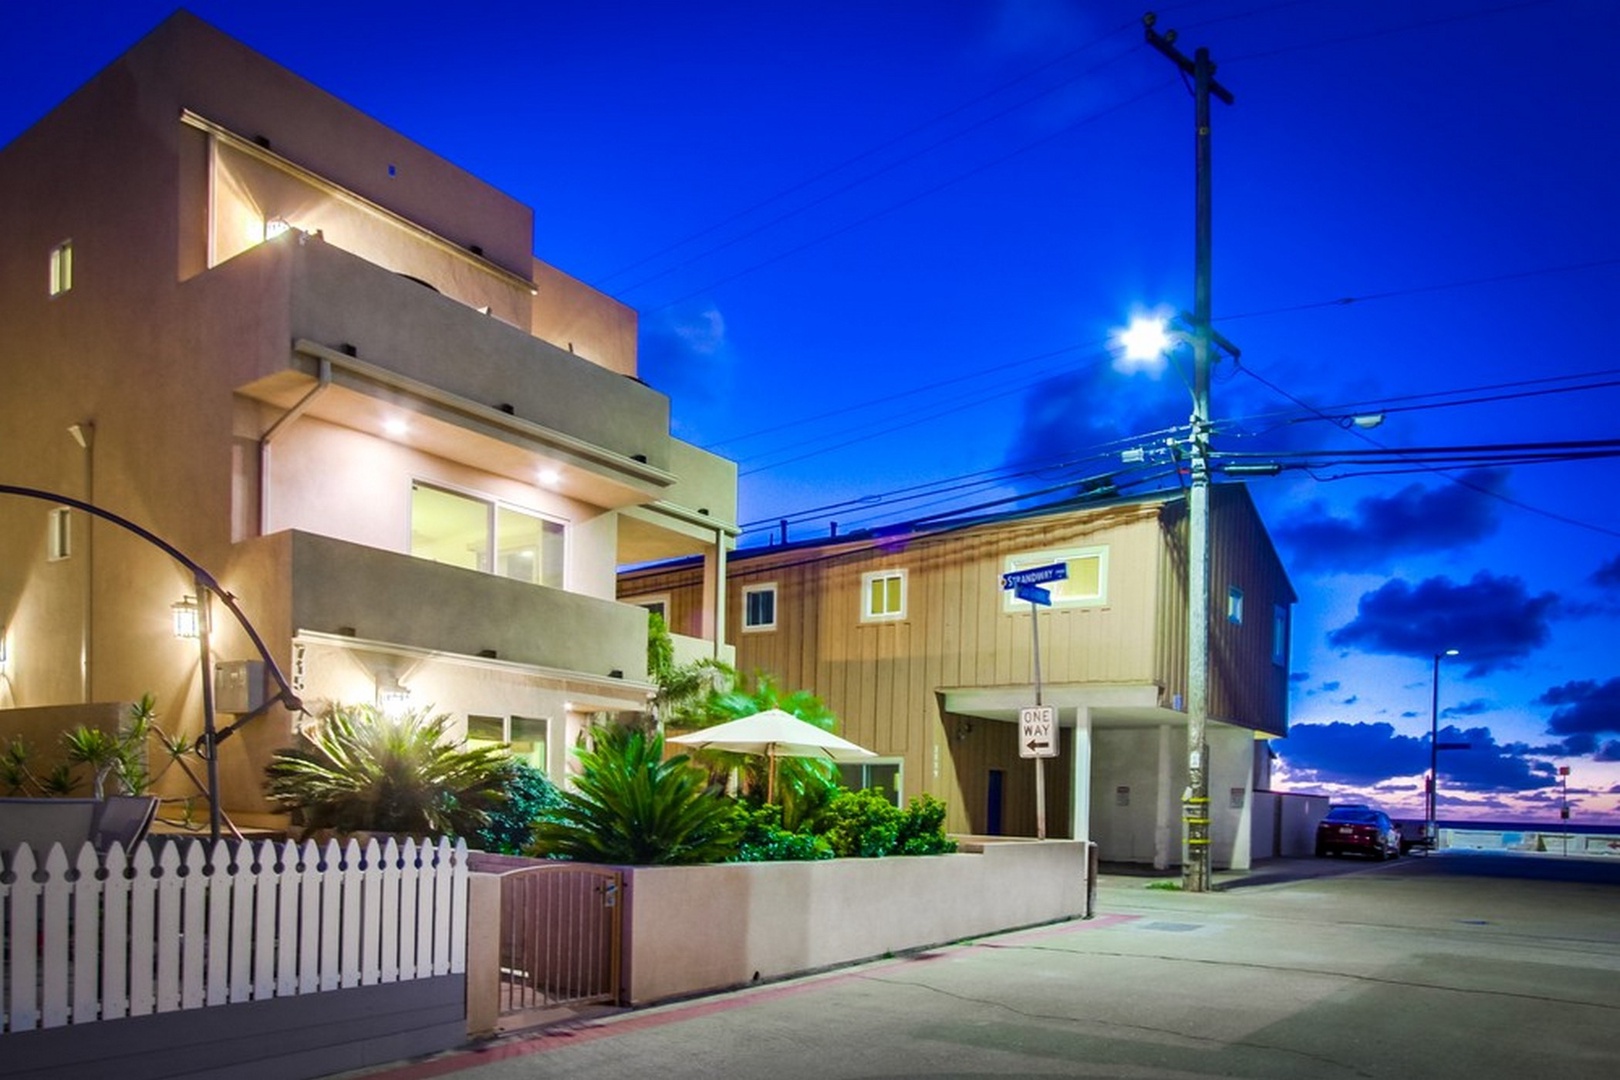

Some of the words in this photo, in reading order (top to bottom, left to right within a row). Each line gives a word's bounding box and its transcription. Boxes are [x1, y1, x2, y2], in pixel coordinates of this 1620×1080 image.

[1007, 569, 1054, 587] STRANDWAY
[1024, 710, 1050, 723] ONE
[1024, 724, 1050, 736] WAY
